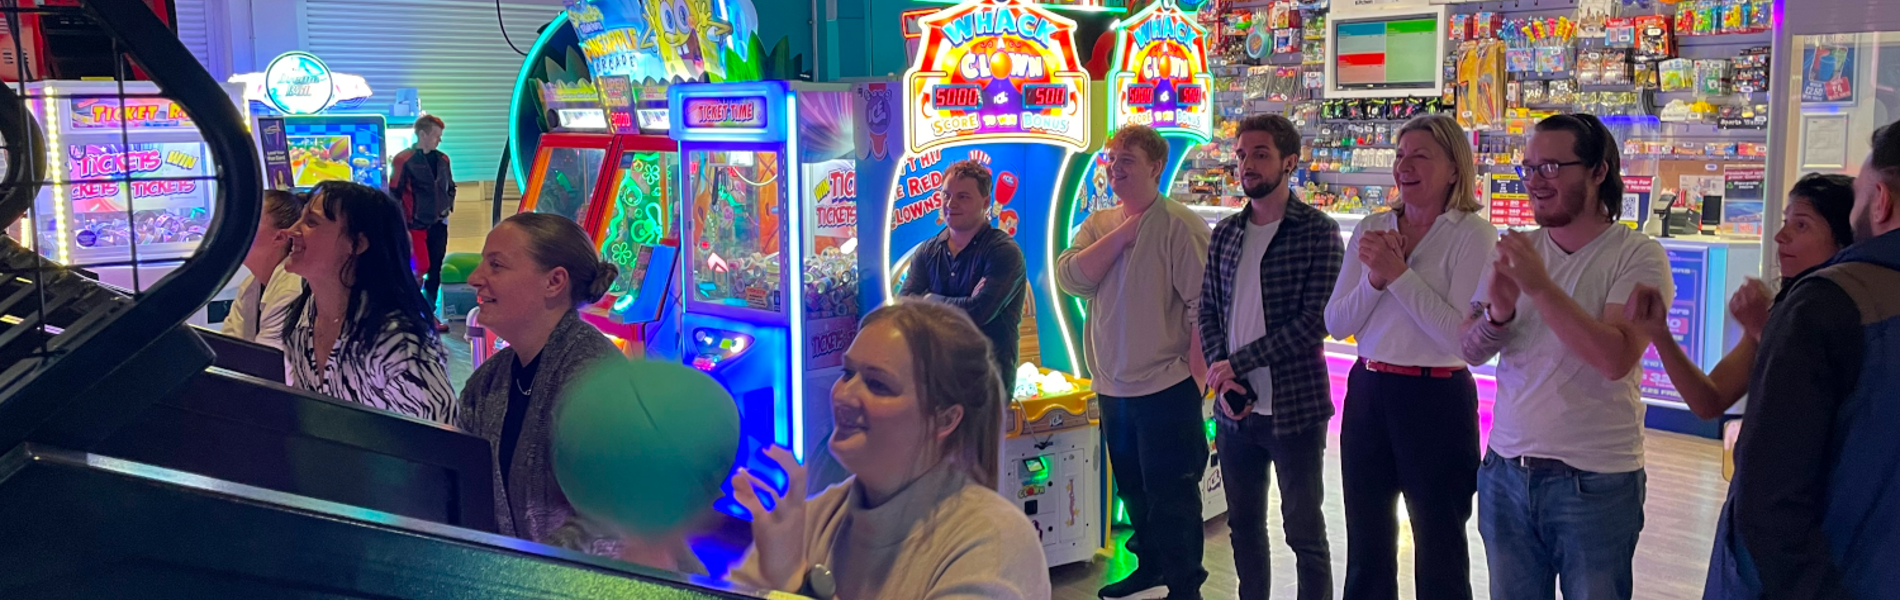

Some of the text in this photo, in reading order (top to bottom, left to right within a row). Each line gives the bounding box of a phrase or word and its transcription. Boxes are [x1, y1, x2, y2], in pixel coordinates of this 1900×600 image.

[942, 9, 1059, 49] WHACK
[1133, 15, 1198, 53] WHACK
[593, 54, 637, 74] ARCADE
[960, 52, 1044, 80] CLOWN
[1143, 55, 1189, 80] CLOWN
[935, 87, 979, 107] 5000
[1035, 87, 1066, 106] 500
[91, 104, 159, 123] TICKET
[698, 102, 754, 122] TICKET TIME
[868, 101, 887, 123] ICE
[932, 113, 979, 135] SCORE
[1022, 112, 1069, 132] BONUS
[79, 149, 162, 178] TICKETS
[165, 150, 199, 170] WIN
[71, 181, 120, 200] CKETS
[131, 180, 196, 199] TICKETS
[830, 170, 856, 200] TIC
[907, 171, 943, 197] RED
[816, 206, 857, 228] TICKETS
[890, 192, 943, 230] LOWNS
